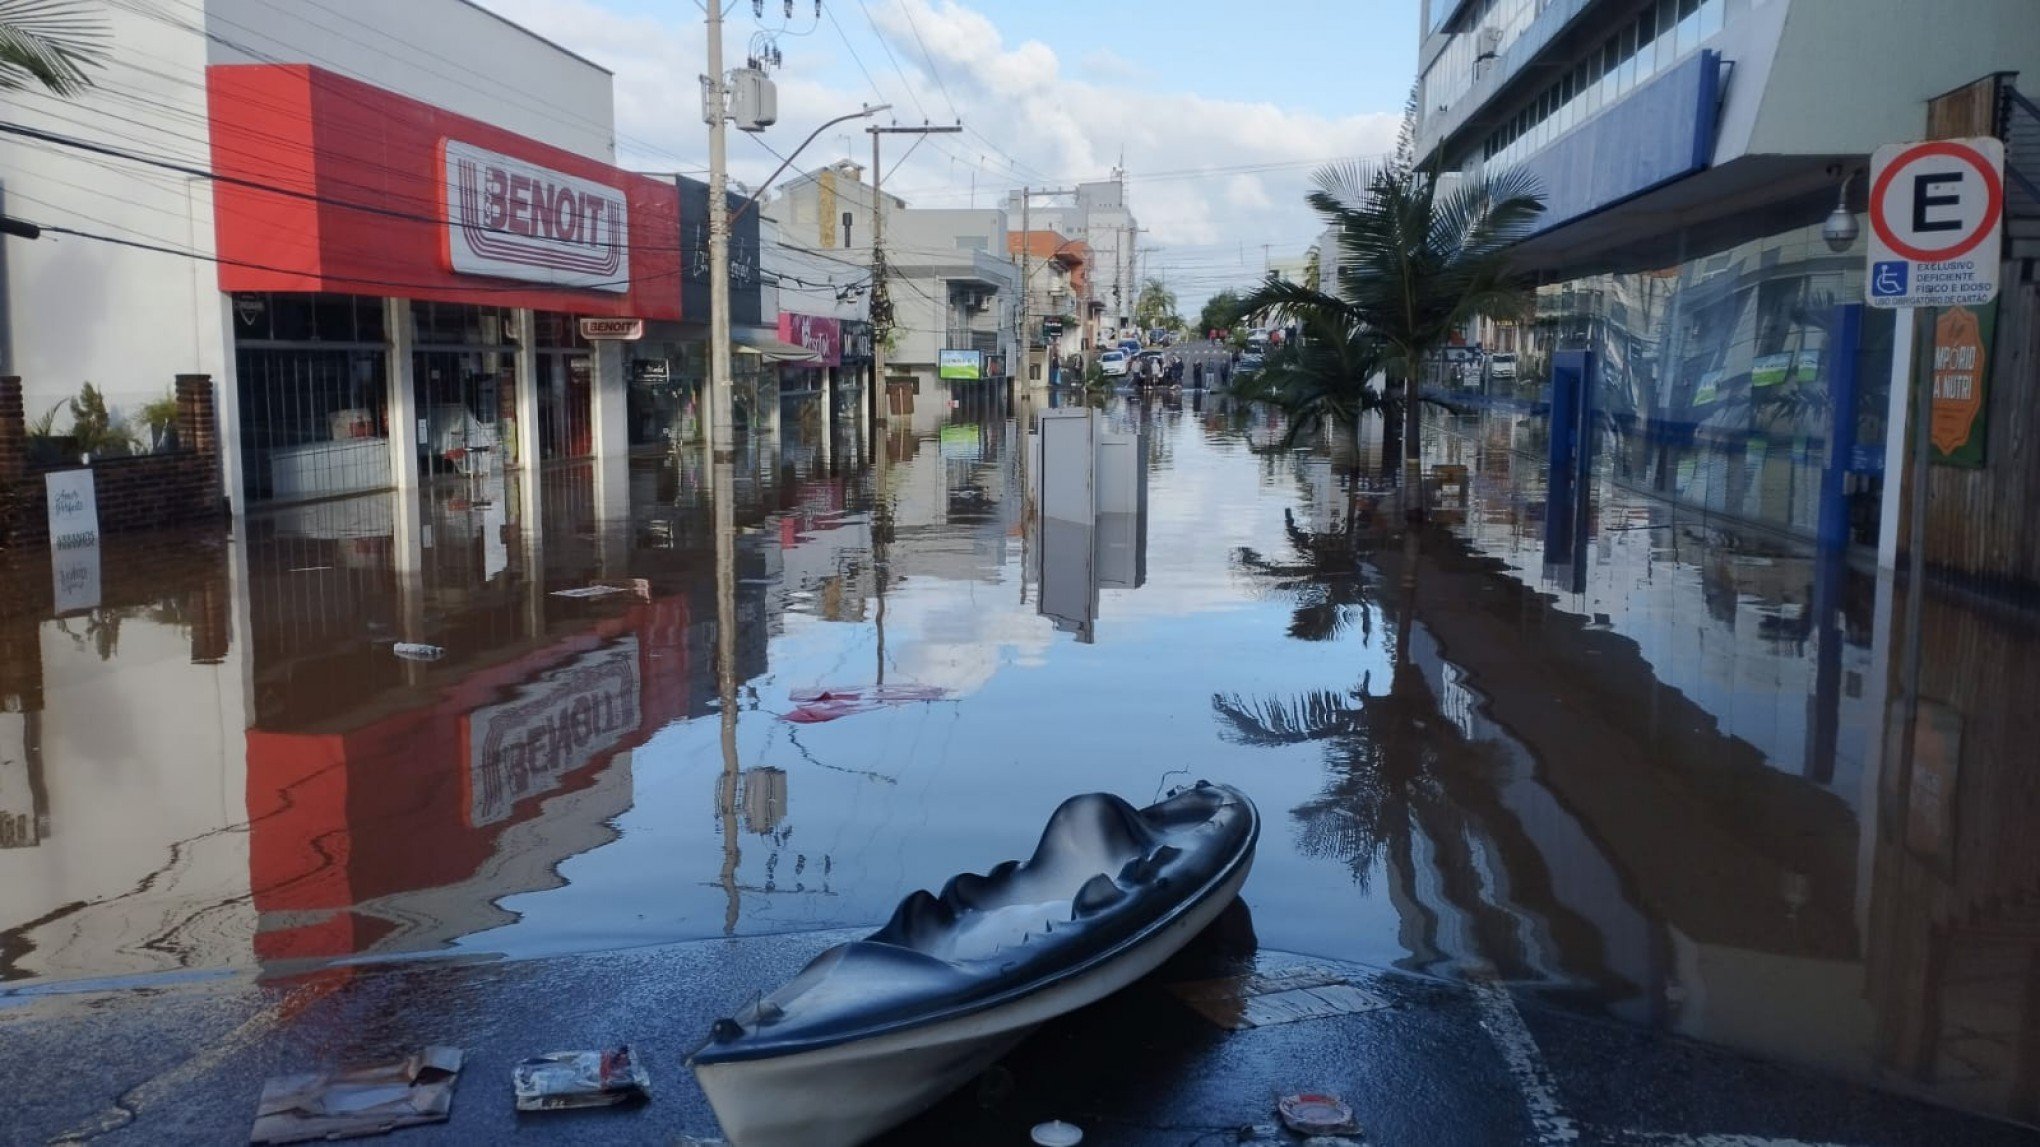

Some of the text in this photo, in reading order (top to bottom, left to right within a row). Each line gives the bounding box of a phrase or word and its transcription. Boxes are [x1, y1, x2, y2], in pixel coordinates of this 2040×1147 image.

[1912, 172, 1963, 232] E
[485, 167, 604, 248] BENOIT
[1917, 261, 1975, 271] EXCLUSIVO
[1916, 272, 1976, 282] DEFICIENTE
[1951, 284, 1958, 292] E
[1961, 282, 1993, 292] IDOSO
[1944, 295, 1955, 304] DE
[589, 321, 632, 332] BENOIT
[1934, 344, 1977, 370] MPÓRIO
